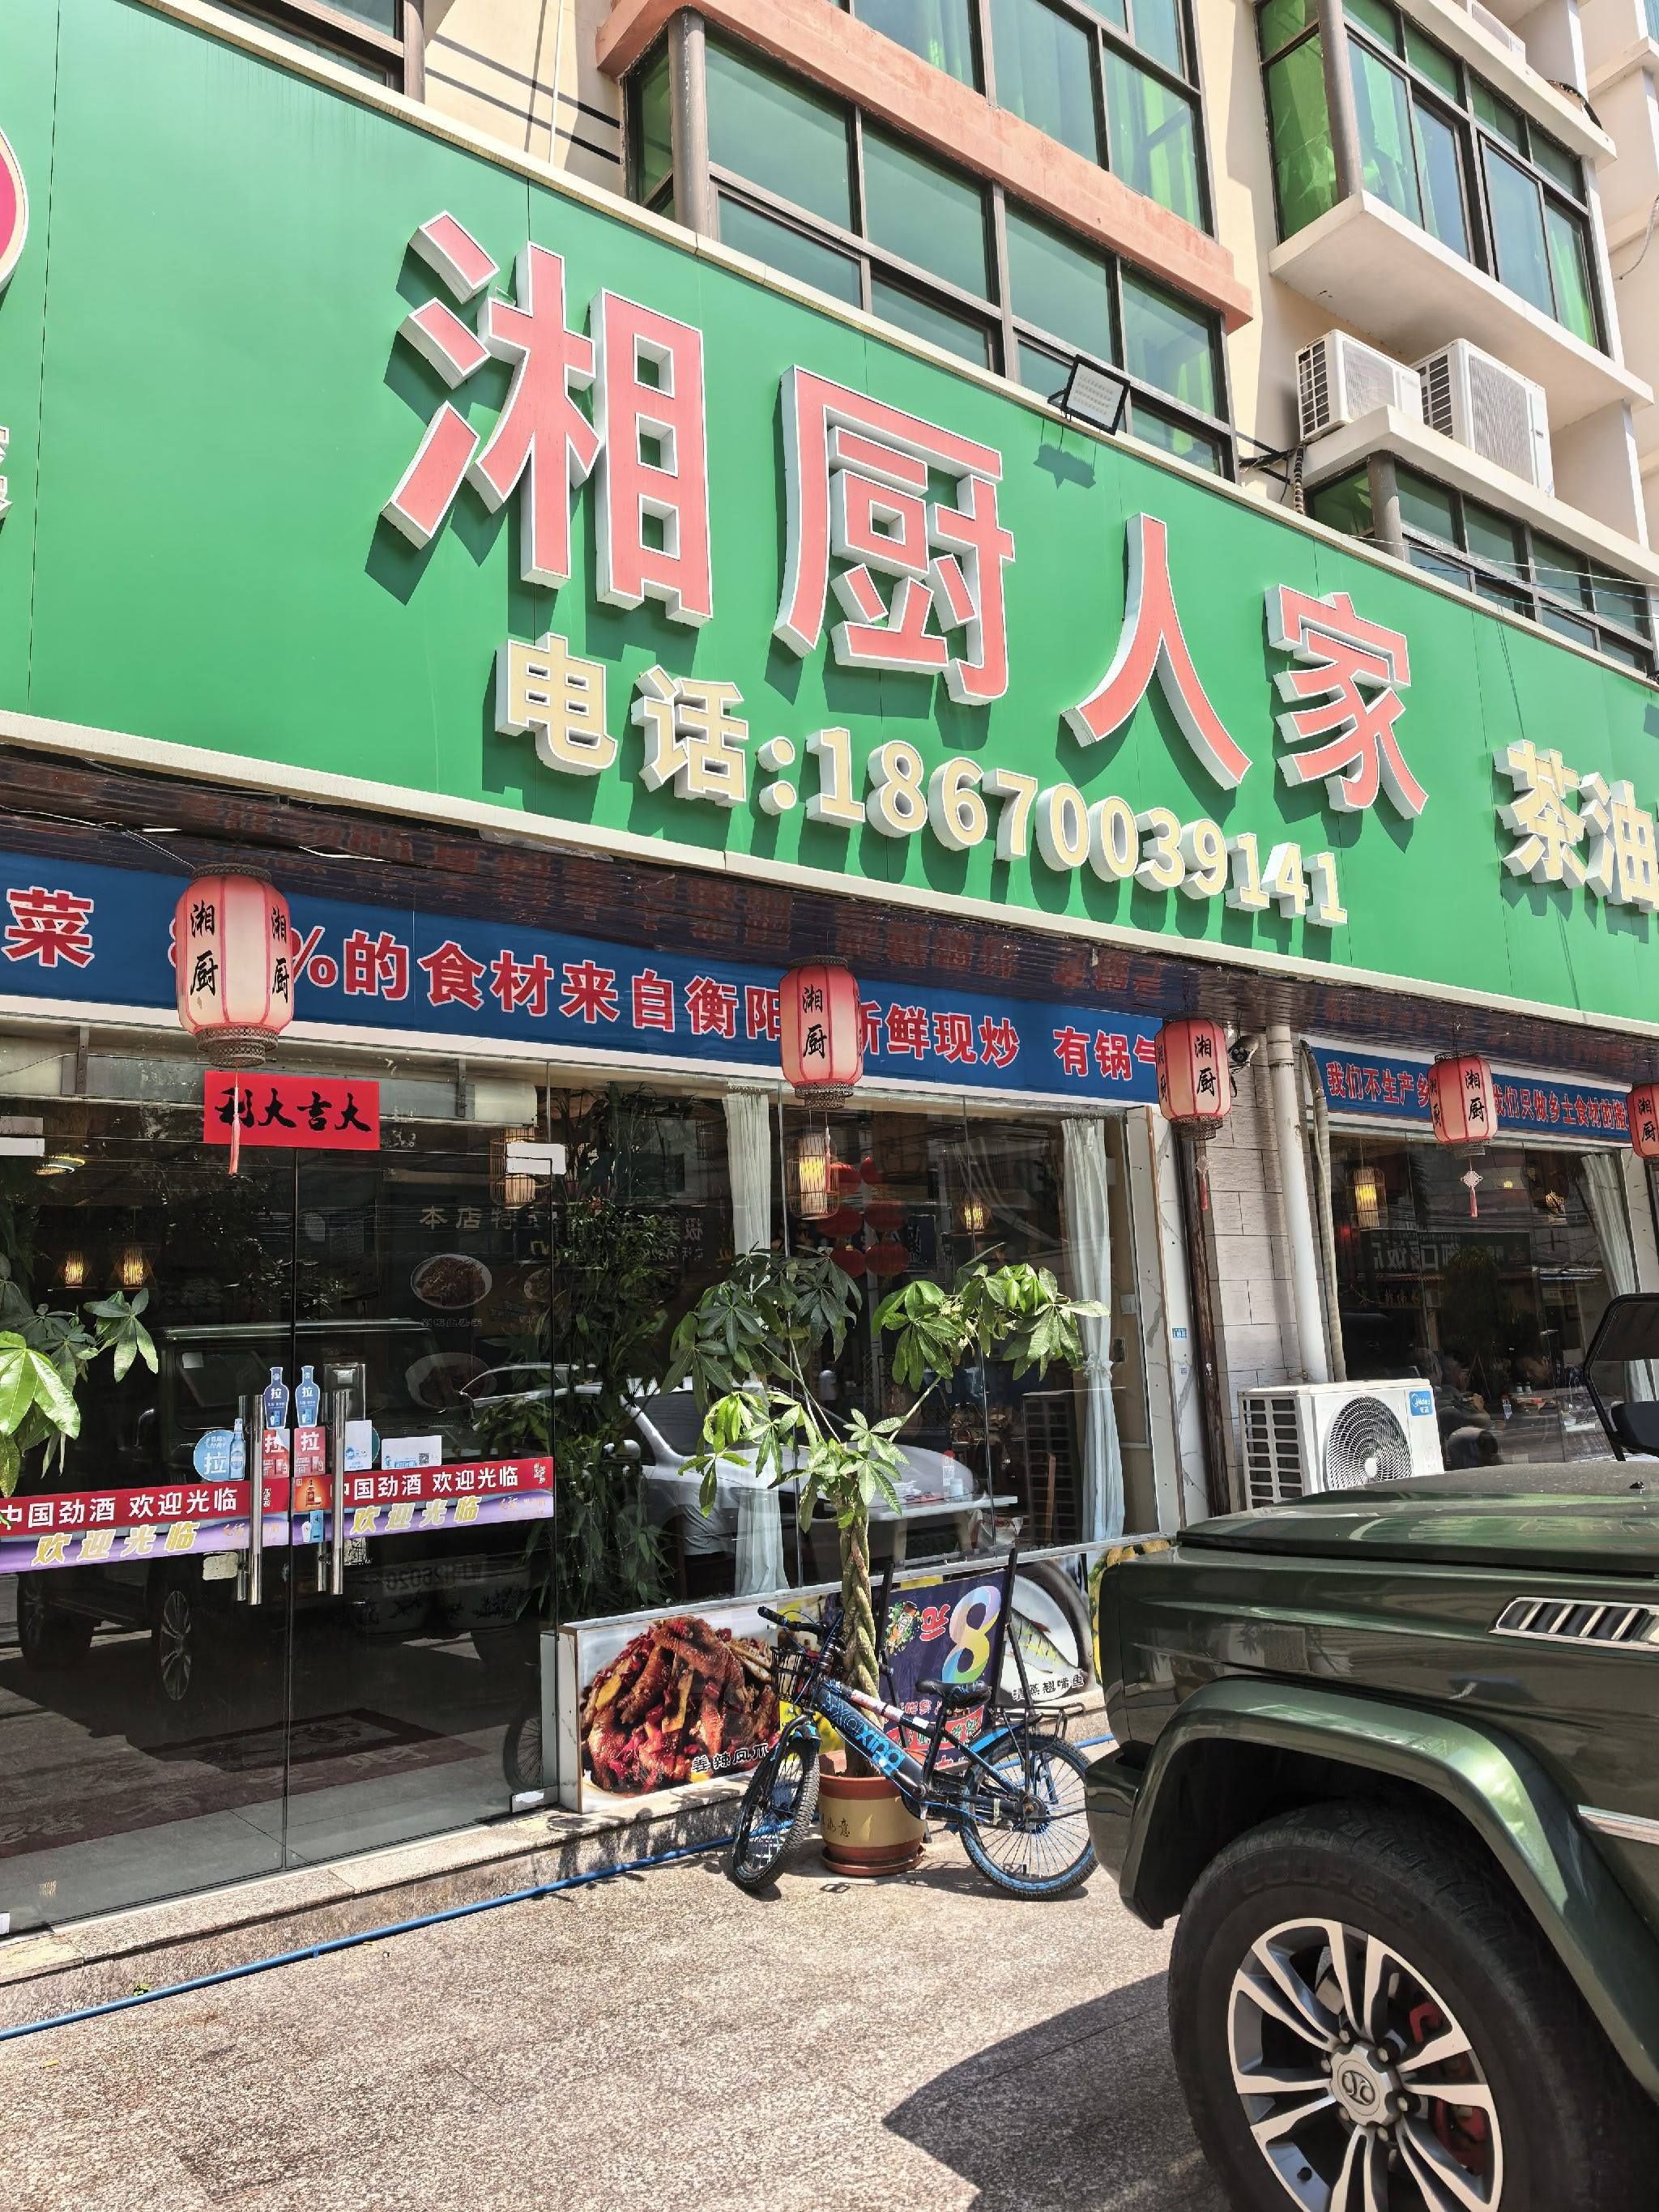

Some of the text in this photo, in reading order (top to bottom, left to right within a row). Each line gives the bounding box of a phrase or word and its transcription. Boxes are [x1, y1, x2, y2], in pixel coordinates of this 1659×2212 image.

[381, 210, 1429, 820] 湘厨人家
[1493, 739, 1659, 914] 茶油
[2, 886, 95, 968] 菜
[190, 900, 219, 996] 湘厨
[271, 906, 290, 1004] 湘厨
[802, 984, 827, 1059] 湘厨
[1194, 1034, 1217, 1097] 湘厨
[1465, 1070, 1486, 1123] 湘厨
[1637, 1097, 1657, 1142] 湘厨
[271, 1387, 282, 1400] 拉
[301, 1386, 313, 1398] 拉
[203, 1451, 228, 1476] 拉
[300, 1431, 321, 1452] 拉
[432, 1465, 518, 1493] 欢迎光临
[128, 1487, 237, 1519] 欢迎光临
[350, 1495, 482, 1535] 欢迎光临
[31, 1521, 200, 1567] 欢迎光临
